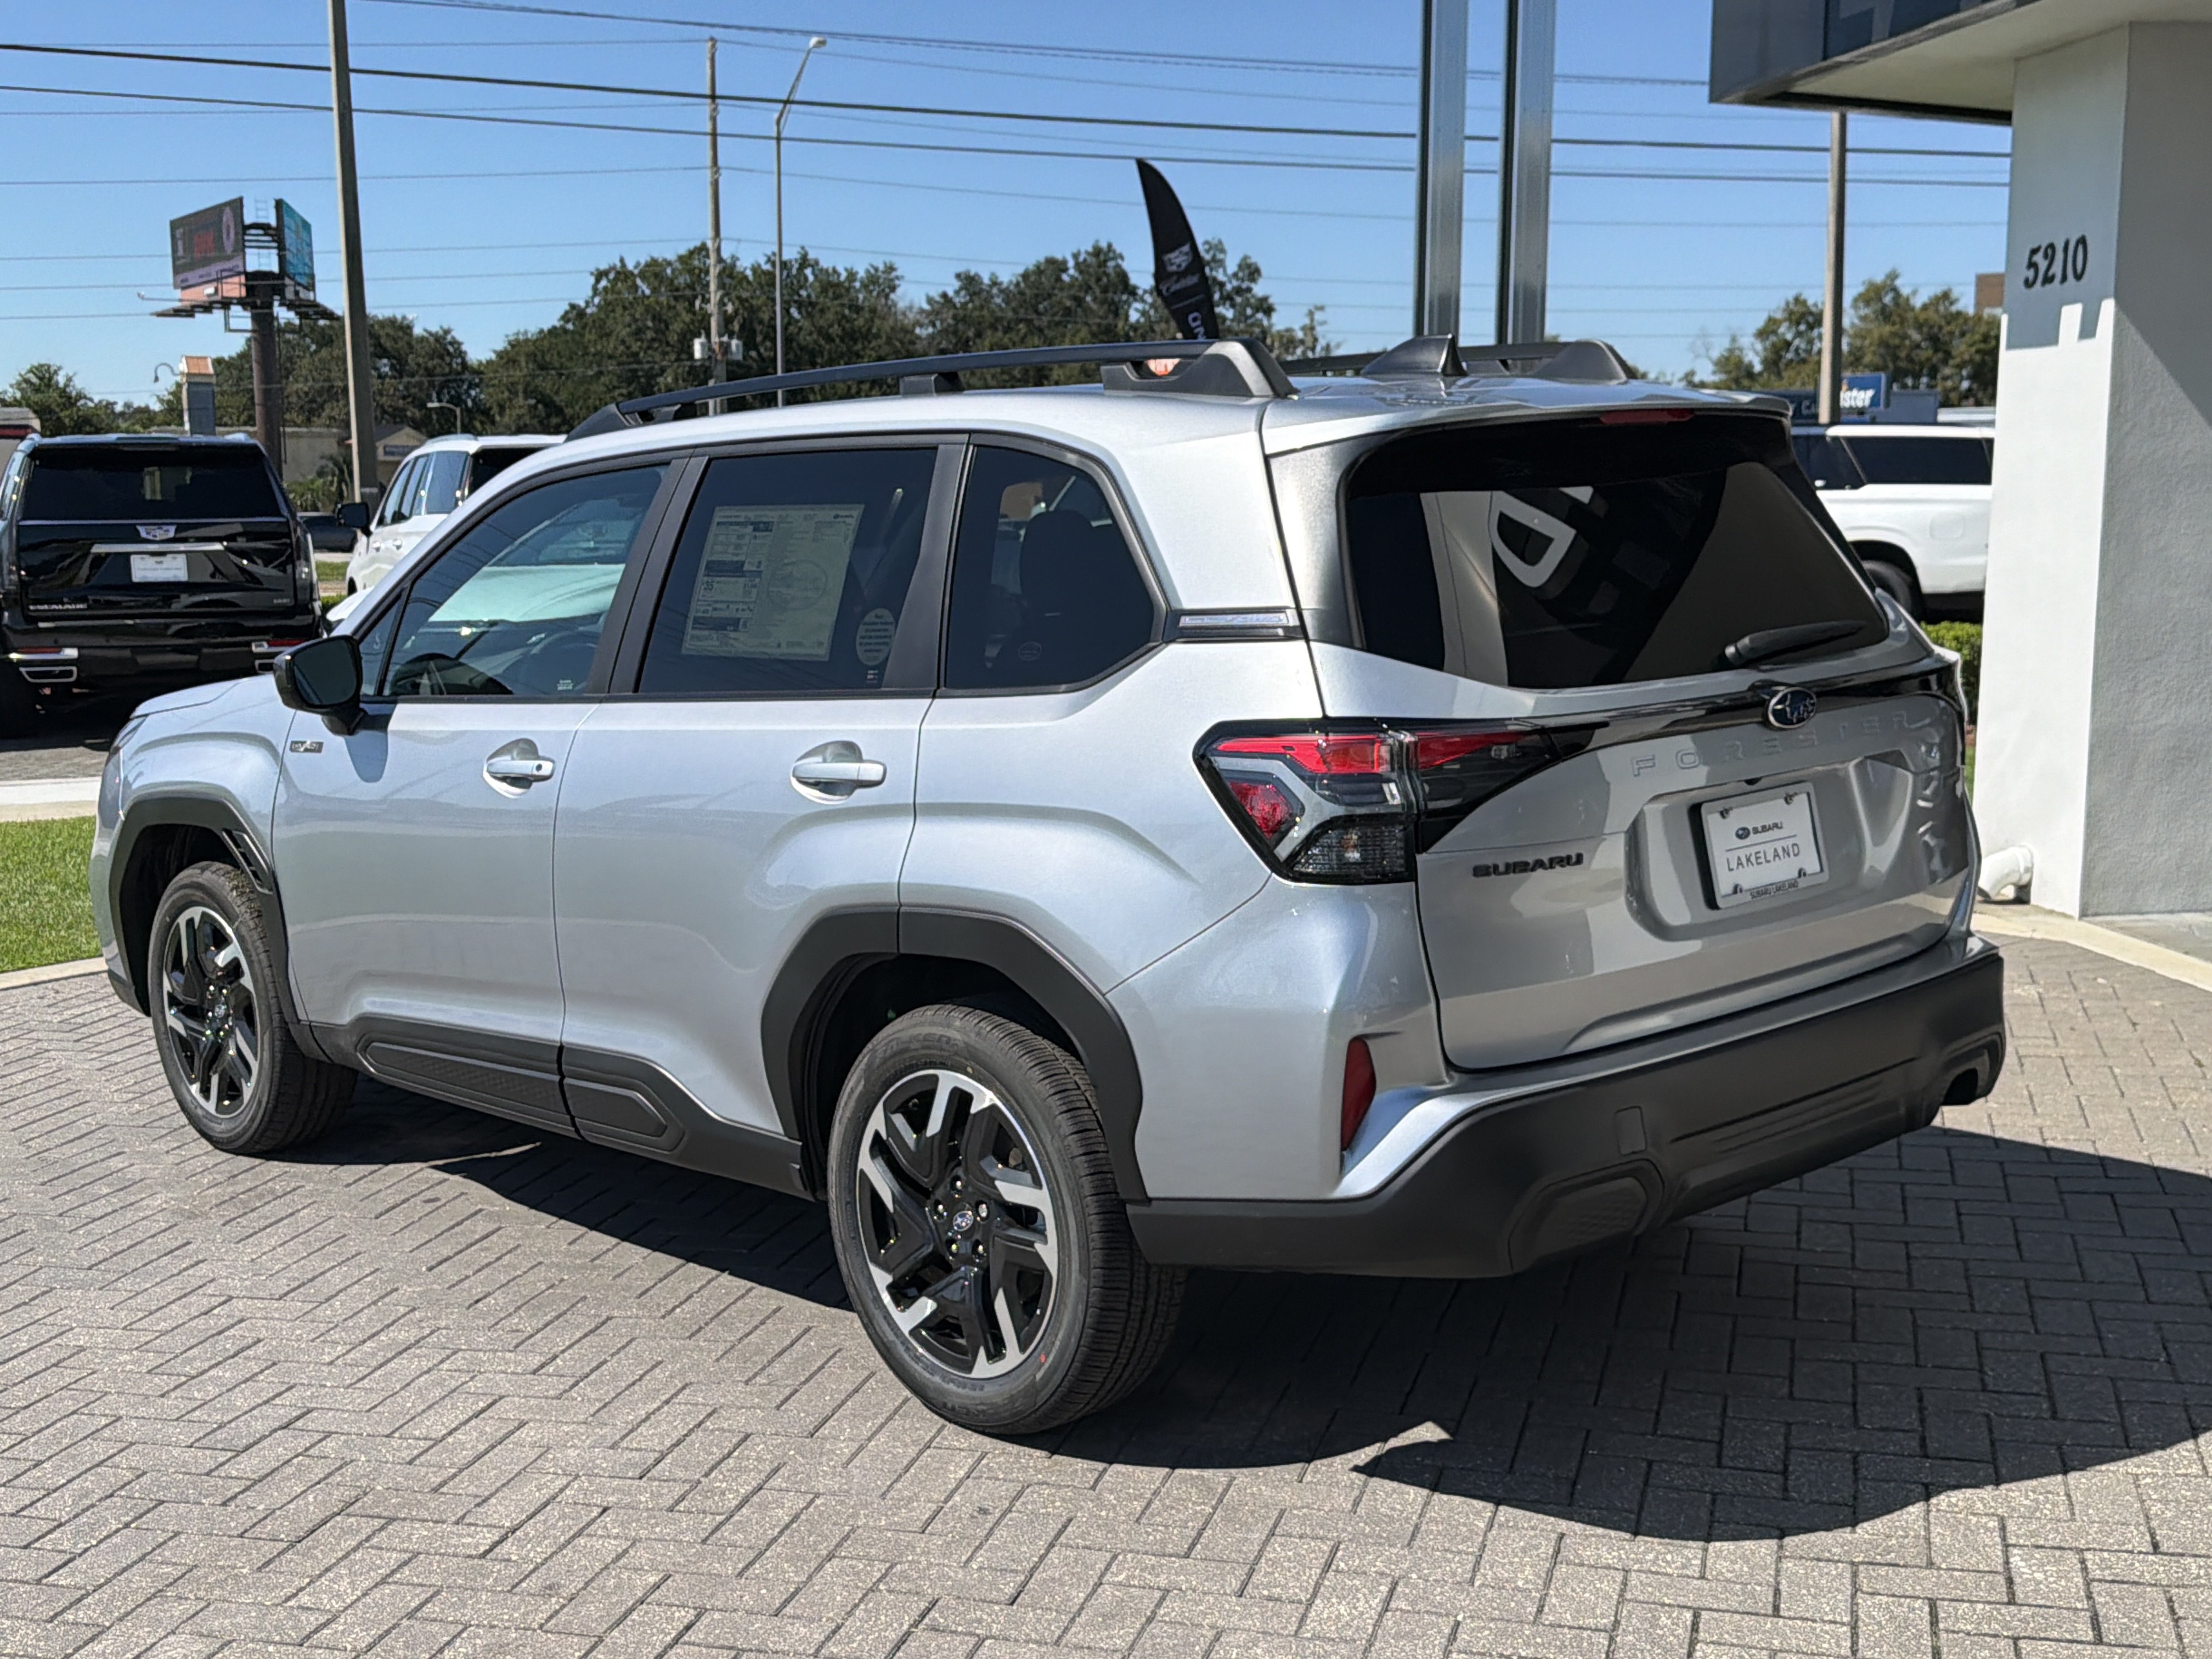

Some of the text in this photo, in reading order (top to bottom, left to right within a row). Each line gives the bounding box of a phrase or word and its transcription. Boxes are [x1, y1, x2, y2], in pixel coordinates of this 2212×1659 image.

[2023, 234, 2087, 289] 5210
[1631, 710, 1908, 777] FORESTER
[1752, 822, 1782, 834] SUBARU
[1472, 852, 1584, 878] SUBARU
[1726, 843, 1800, 871] LAKELAND
